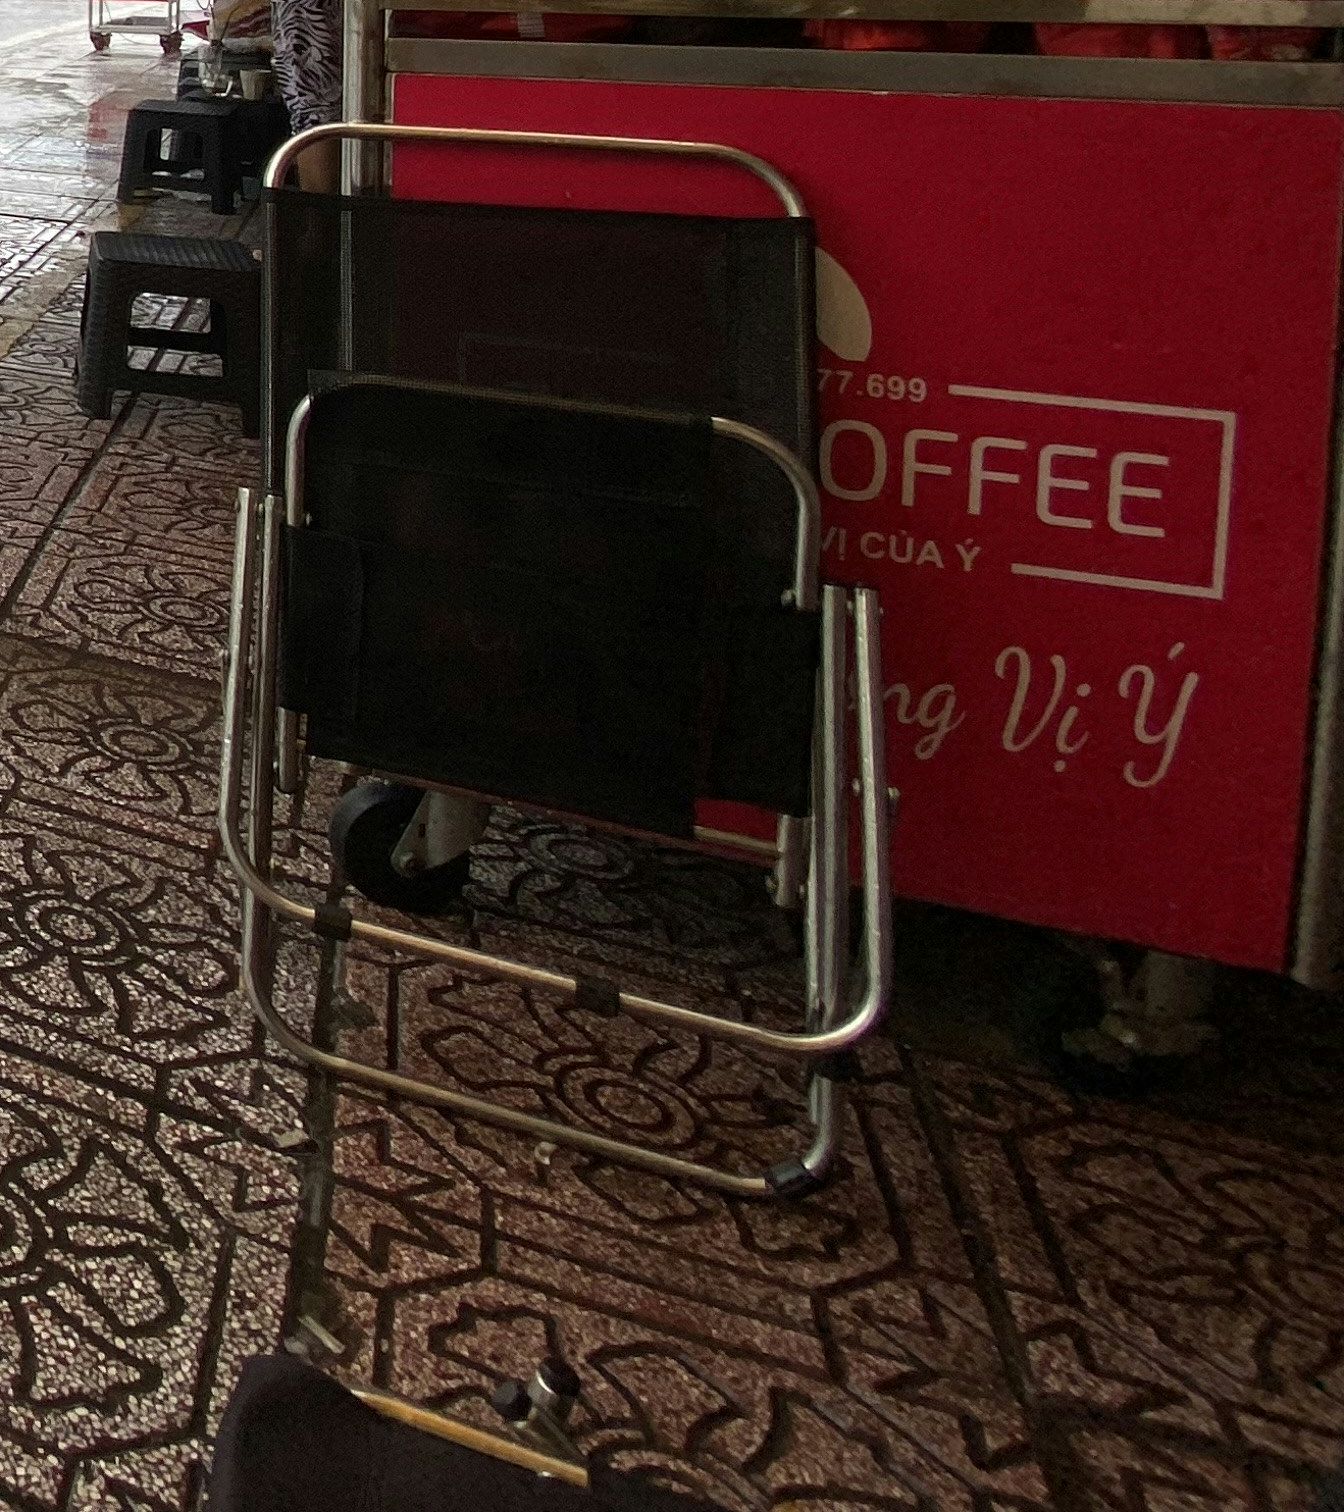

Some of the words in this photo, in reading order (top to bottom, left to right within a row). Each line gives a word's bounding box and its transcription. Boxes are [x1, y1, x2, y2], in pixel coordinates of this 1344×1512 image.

[817, 368, 928, 403] 77.699
[818, 419, 1170, 539] OFFEE
[860, 530, 945, 569] CỦA
[955, 537, 982, 573] Ý
[993, 645, 1093, 773] Vị
[1117, 641, 1200, 789] Ý
